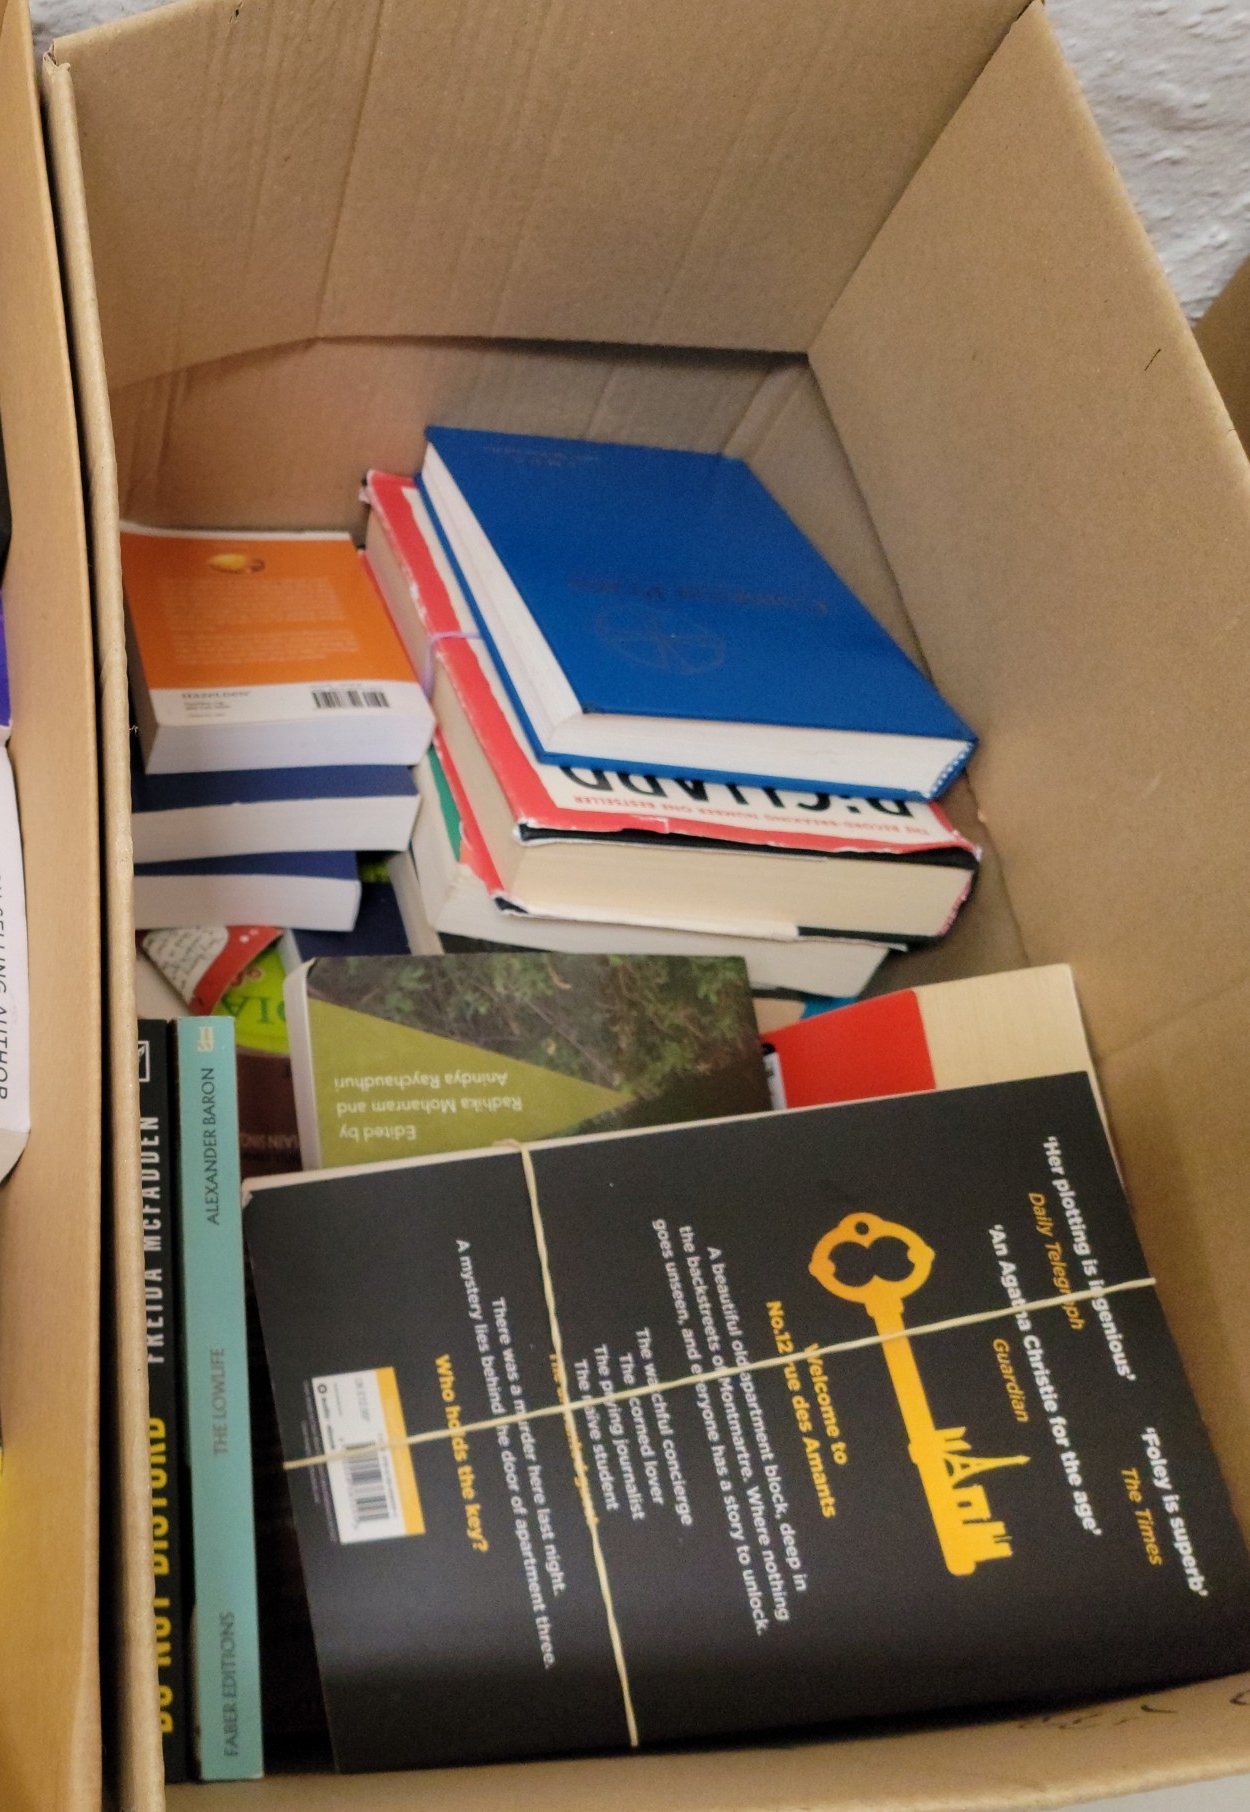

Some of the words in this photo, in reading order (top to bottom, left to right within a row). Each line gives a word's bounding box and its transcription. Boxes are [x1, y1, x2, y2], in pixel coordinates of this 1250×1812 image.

[573, 796, 656, 810] BESTSELLER
[200, 1067, 216, 1126] BARON
[333, 1069, 441, 1091] Raychaudhuri
[448, 1068, 509, 1087] Anindya
[336, 1100, 367, 1118] and
[370, 1097, 457, 1115] Mohanram
[460, 1095, 523, 1112] Radhika
[338, 1125, 360, 1143] by
[364, 1124, 417, 1141] Edited
[203, 1129, 220, 1226] ALEXANDER
[652, 1218, 674, 1260] goes
[1028, 1192, 1054, 1238] Daily
[1052, 1178, 1091, 1257] plotting
[1081, 1258, 1098, 1278] is
[456, 1238, 471, 1255] A
[679, 1225, 696, 1255] the
[707, 1245, 723, 1262] A
[459, 1254, 484, 1322] mystery
[664, 1261, 688, 1326] unseen,
[686, 1256, 722, 1354] backstreets
[712, 1263, 743, 1339] beautiful
[473, 1322, 494, 1353] lies
[491, 1296, 513, 1338] There
[766, 1300, 795, 1356] No.12
[501, 1341, 518, 1381] was
[593, 1343, 609, 1374] The
[635, 1327, 654, 1363] The
[681, 1328, 702, 1362] and
[731, 1340, 748, 1367] old
[210, 1347, 227, 1420] LOWLIFE
[434, 1353, 456, 1403] Who
[480, 1353, 505, 1416] behind
[509, 1382, 522, 1396] a
[642, 1364, 674, 1438] wachful
[780, 1361, 803, 1393] rue
[992, 1338, 1029, 1423] Guardian
[598, 1376, 624, 1437] pying
[718, 1376, 754, 1479] Montmartre.
[792, 1394, 812, 1433] des
[805, 1343, 840, 1438] Welcome
[830, 1441, 847, 1466] to
[1023, 1334, 1056, 1413] Christie
[1048, 1415, 1070, 1449] for
[1060, 1450, 1082, 1484] the
[213, 1421, 229, 1457] THE
[512, 1397, 538, 1463] mrder
[574, 1358, 593, 1391] The
[592, 1442, 619, 1513] student
[618, 1352, 636, 1387] The
[628, 1388, 654, 1459] corned
[644, 1461, 666, 1507] lover
[456, 1463, 476, 1502] the
[499, 1446, 518, 1492] door
[527, 1464, 546, 1506] here
[611, 1438, 646, 1523] journalist
[662, 1439, 692, 1527] concierge
[711, 1445, 729, 1477] has
[801, 1435, 836, 1519] Amants
[509, 1492, 525, 1517] of
[720, 1479, 732, 1493] a
[764, 1465, 789, 1517] block,
[1162, 1493, 1179, 1514] is
[464, 1504, 490, 1554] key?
[536, 1507, 555, 1542] last
[723, 1494, 746, 1542] story
[747, 1485, 771, 1546] Where
[1121, 1467, 1143, 1503] The
[1134, 1508, 1164, 1566] Times
[514, 1516, 545, 1609] apartment
[542, 1542, 567, 1598] night.
[737, 1543, 753, 1566] to
[780, 1522, 802, 1571] deep
[743, 1569, 769, 1637] unlock.
[762, 1551, 790, 1622] nothing
[793, 1573, 807, 1593] in
[218, 1610, 236, 1691] EDITIONS
[533, 1608, 557, 1671] three.
[221, 1701, 238, 1757] FABER
